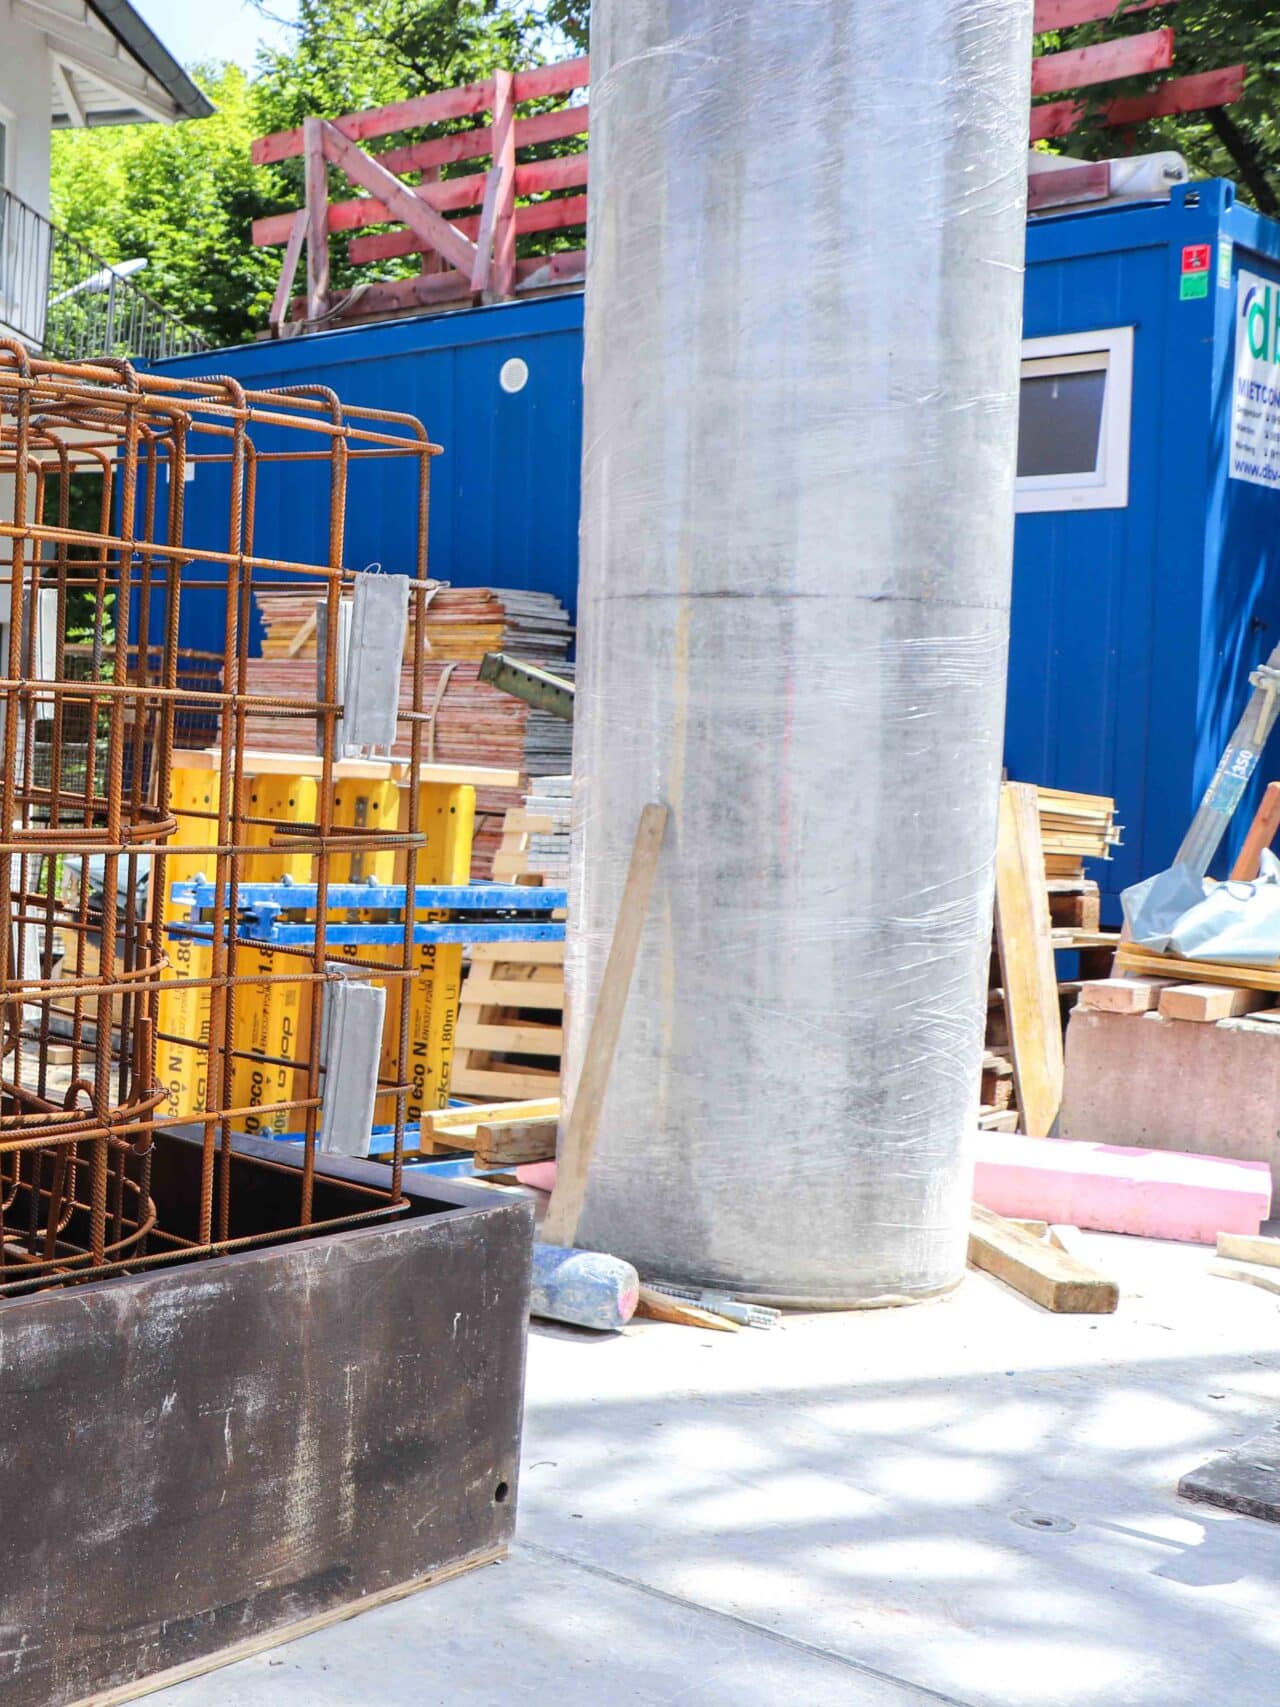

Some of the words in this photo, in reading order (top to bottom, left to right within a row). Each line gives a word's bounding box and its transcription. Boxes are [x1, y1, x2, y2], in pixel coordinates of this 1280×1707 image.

[413, 1041, 427, 1056] N
[441, 1009, 454, 1054] 1.80m
[412, 1064, 425, 1100] eco
